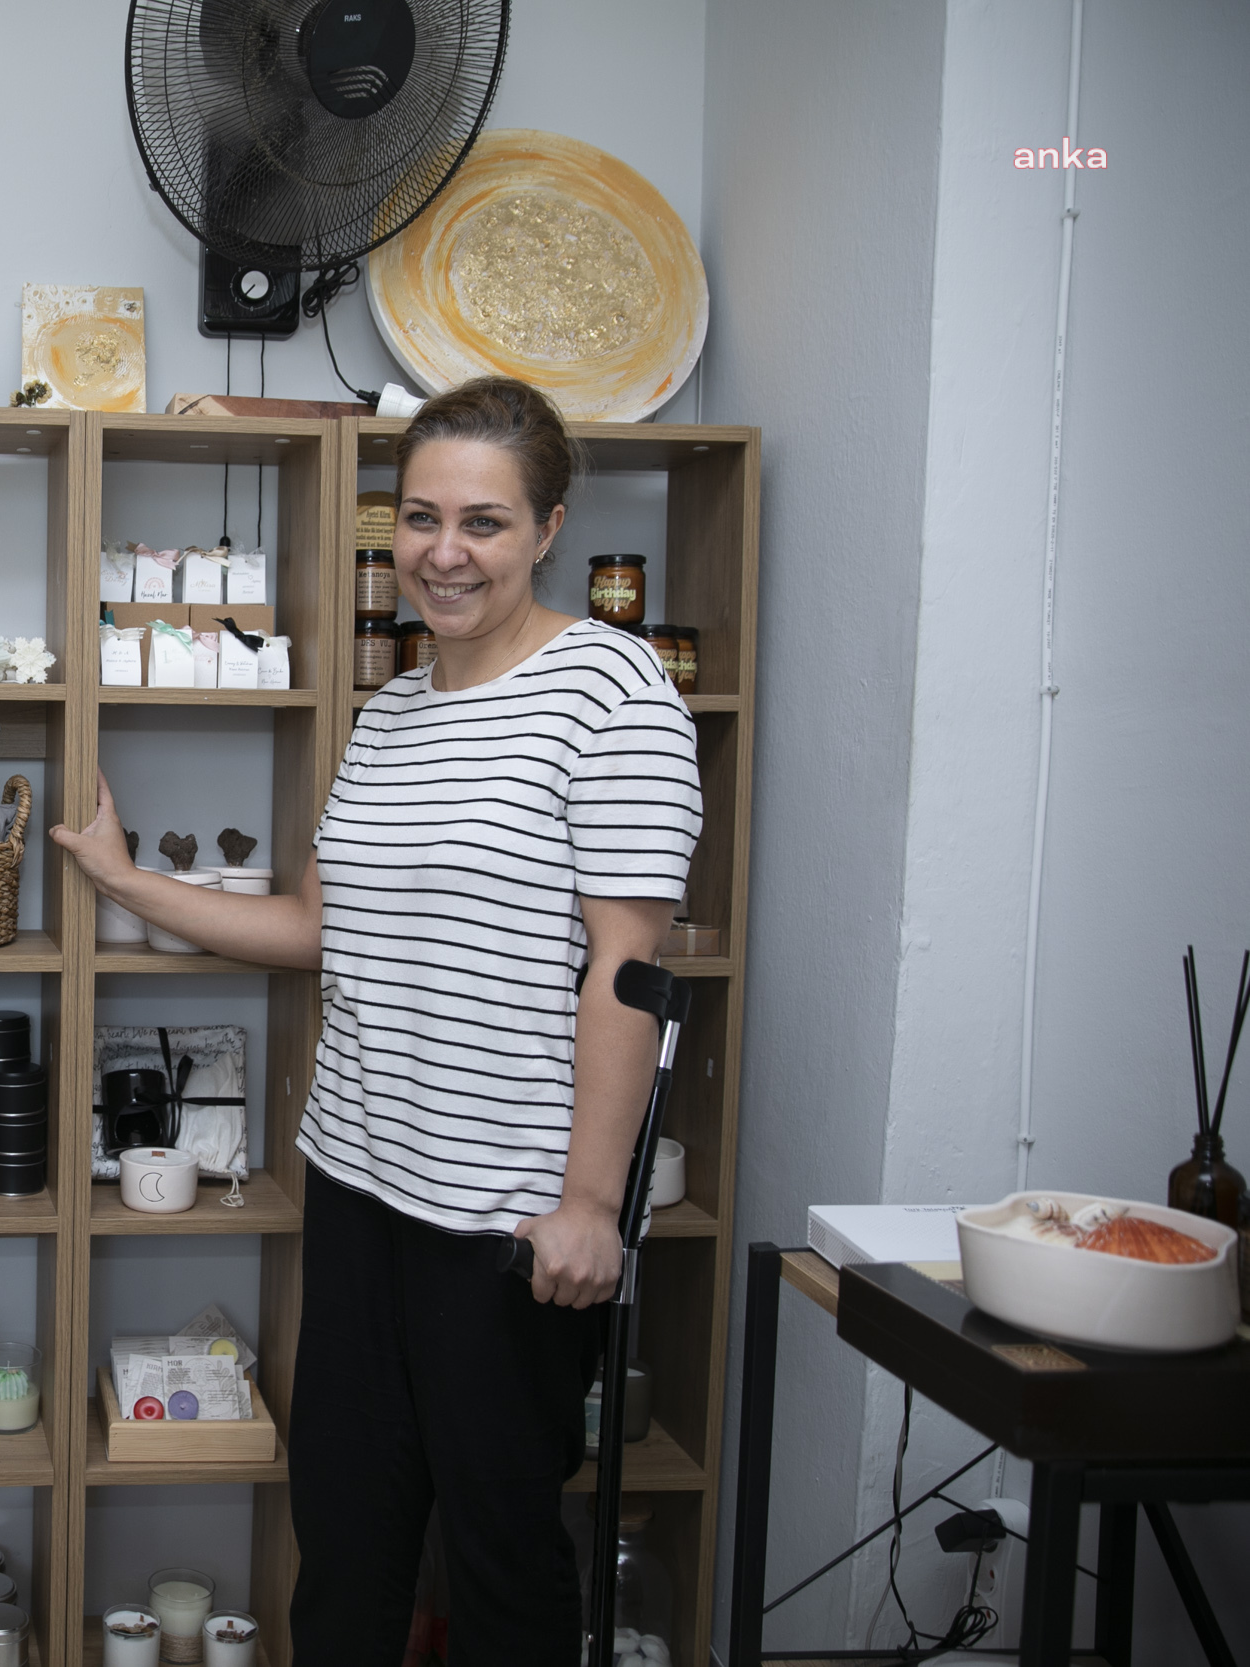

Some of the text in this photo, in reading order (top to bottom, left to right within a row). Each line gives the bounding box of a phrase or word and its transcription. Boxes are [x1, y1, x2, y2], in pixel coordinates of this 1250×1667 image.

[343, 13, 362, 22] RAKS
[594, 575, 632, 589] Happy
[590, 587, 637, 601] Birthday
[418, 641, 438, 649] Oren
[167, 1360, 183, 1371] MOR
